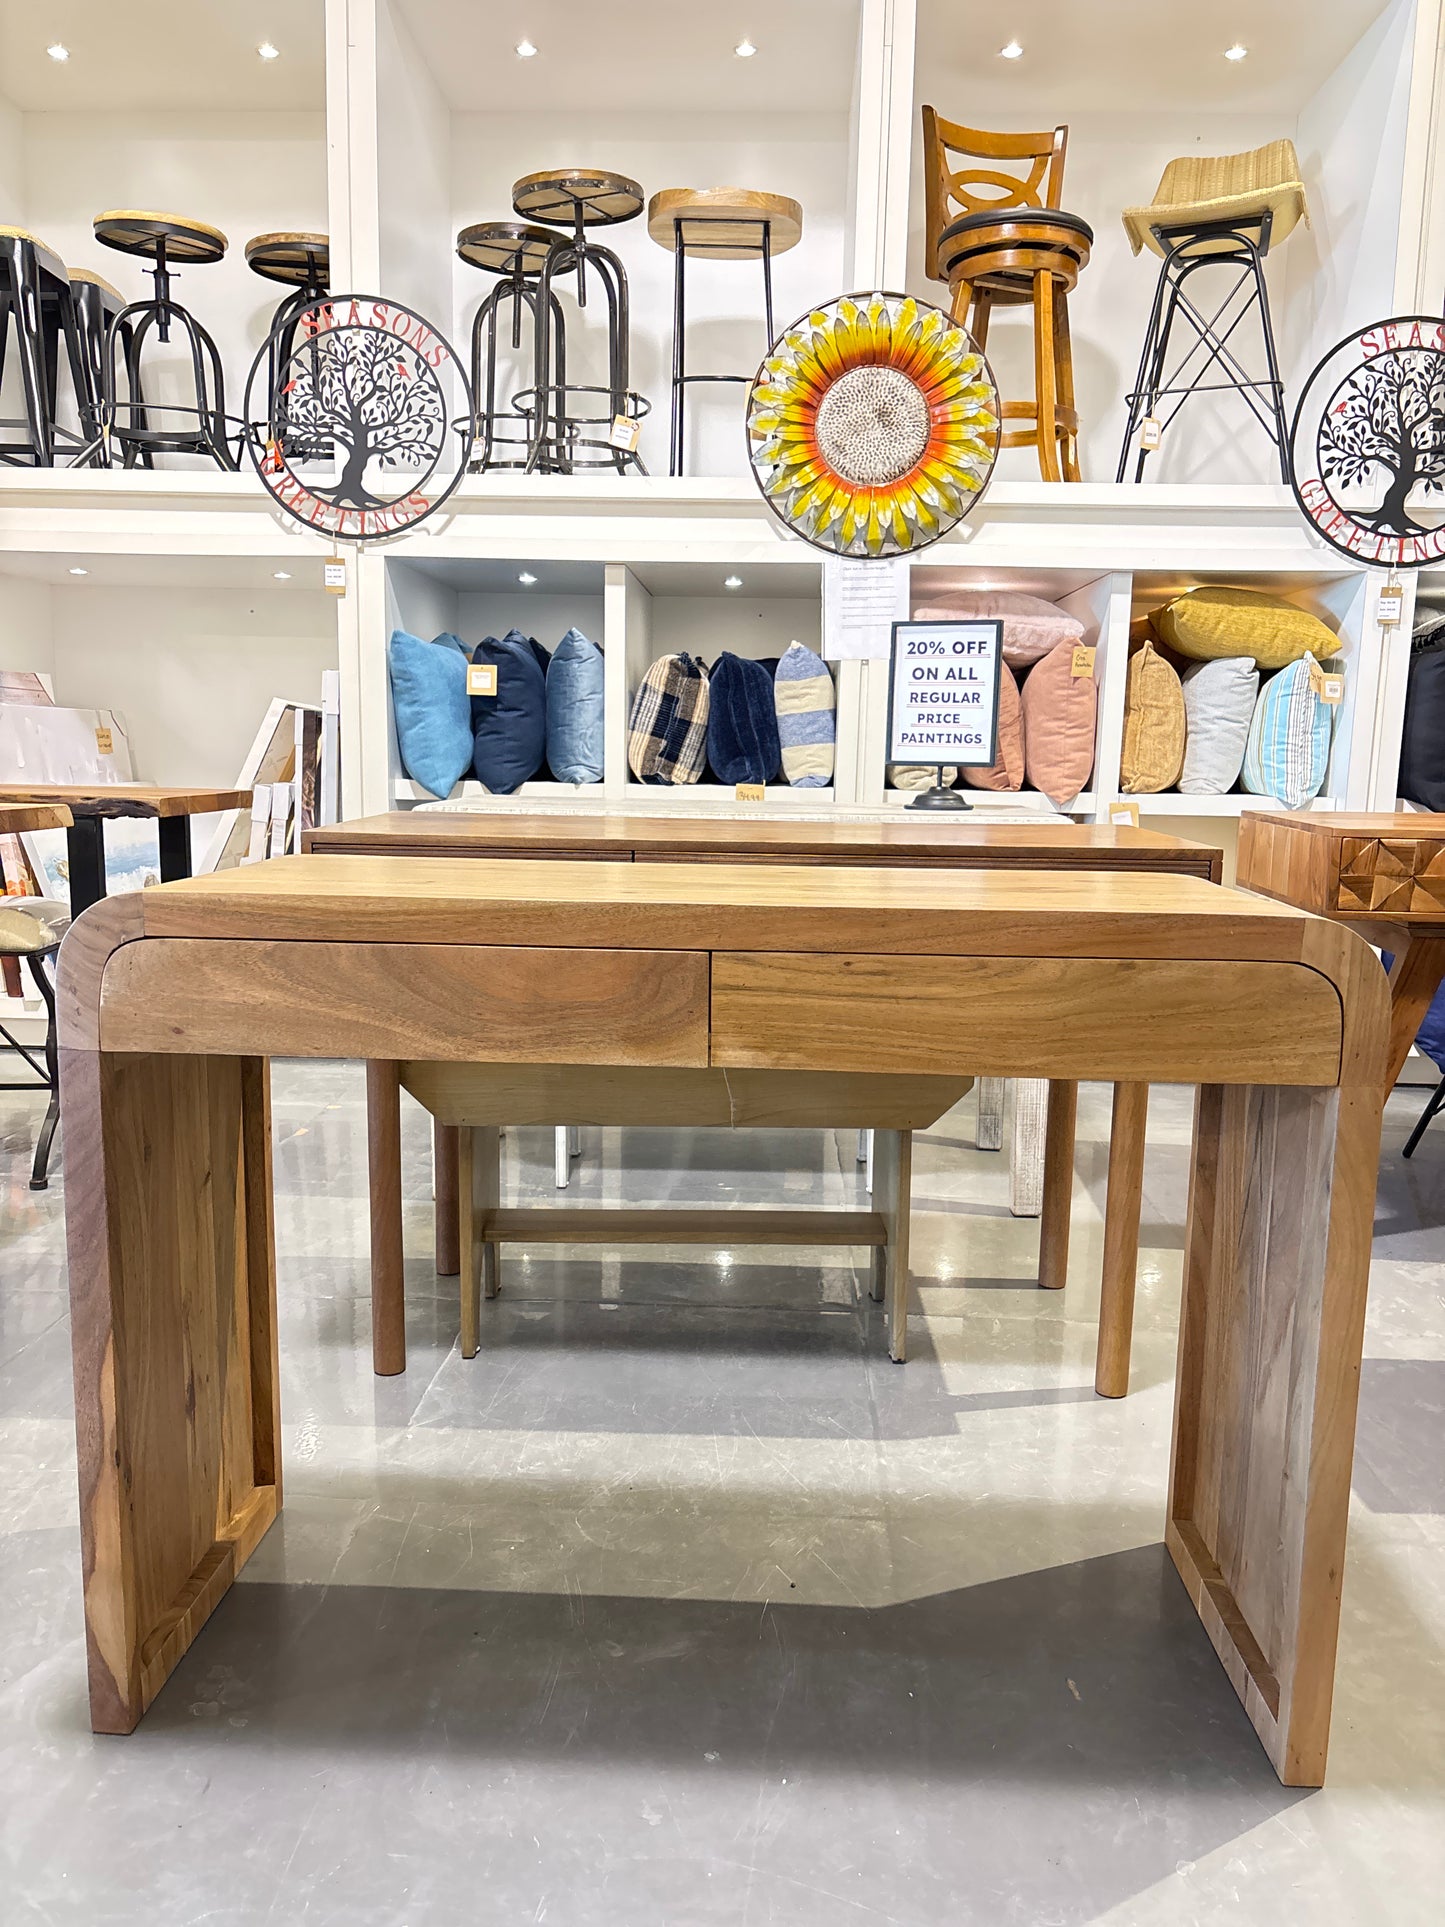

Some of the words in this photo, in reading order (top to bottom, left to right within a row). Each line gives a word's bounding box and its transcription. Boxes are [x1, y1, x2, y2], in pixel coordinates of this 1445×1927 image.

[300, 301, 450, 368] SEASONS
[260, 455, 430, 535] GREETINGS
[907, 641, 945, 655] 20%
[952, 641, 987, 654] OFF
[912, 667, 938, 680] ON
[945, 667, 978, 680] ALL
[910, 692, 981, 704] REGULAR
[917, 713, 961, 724] PRICE
[901, 733, 982, 744] PAINTINGS
